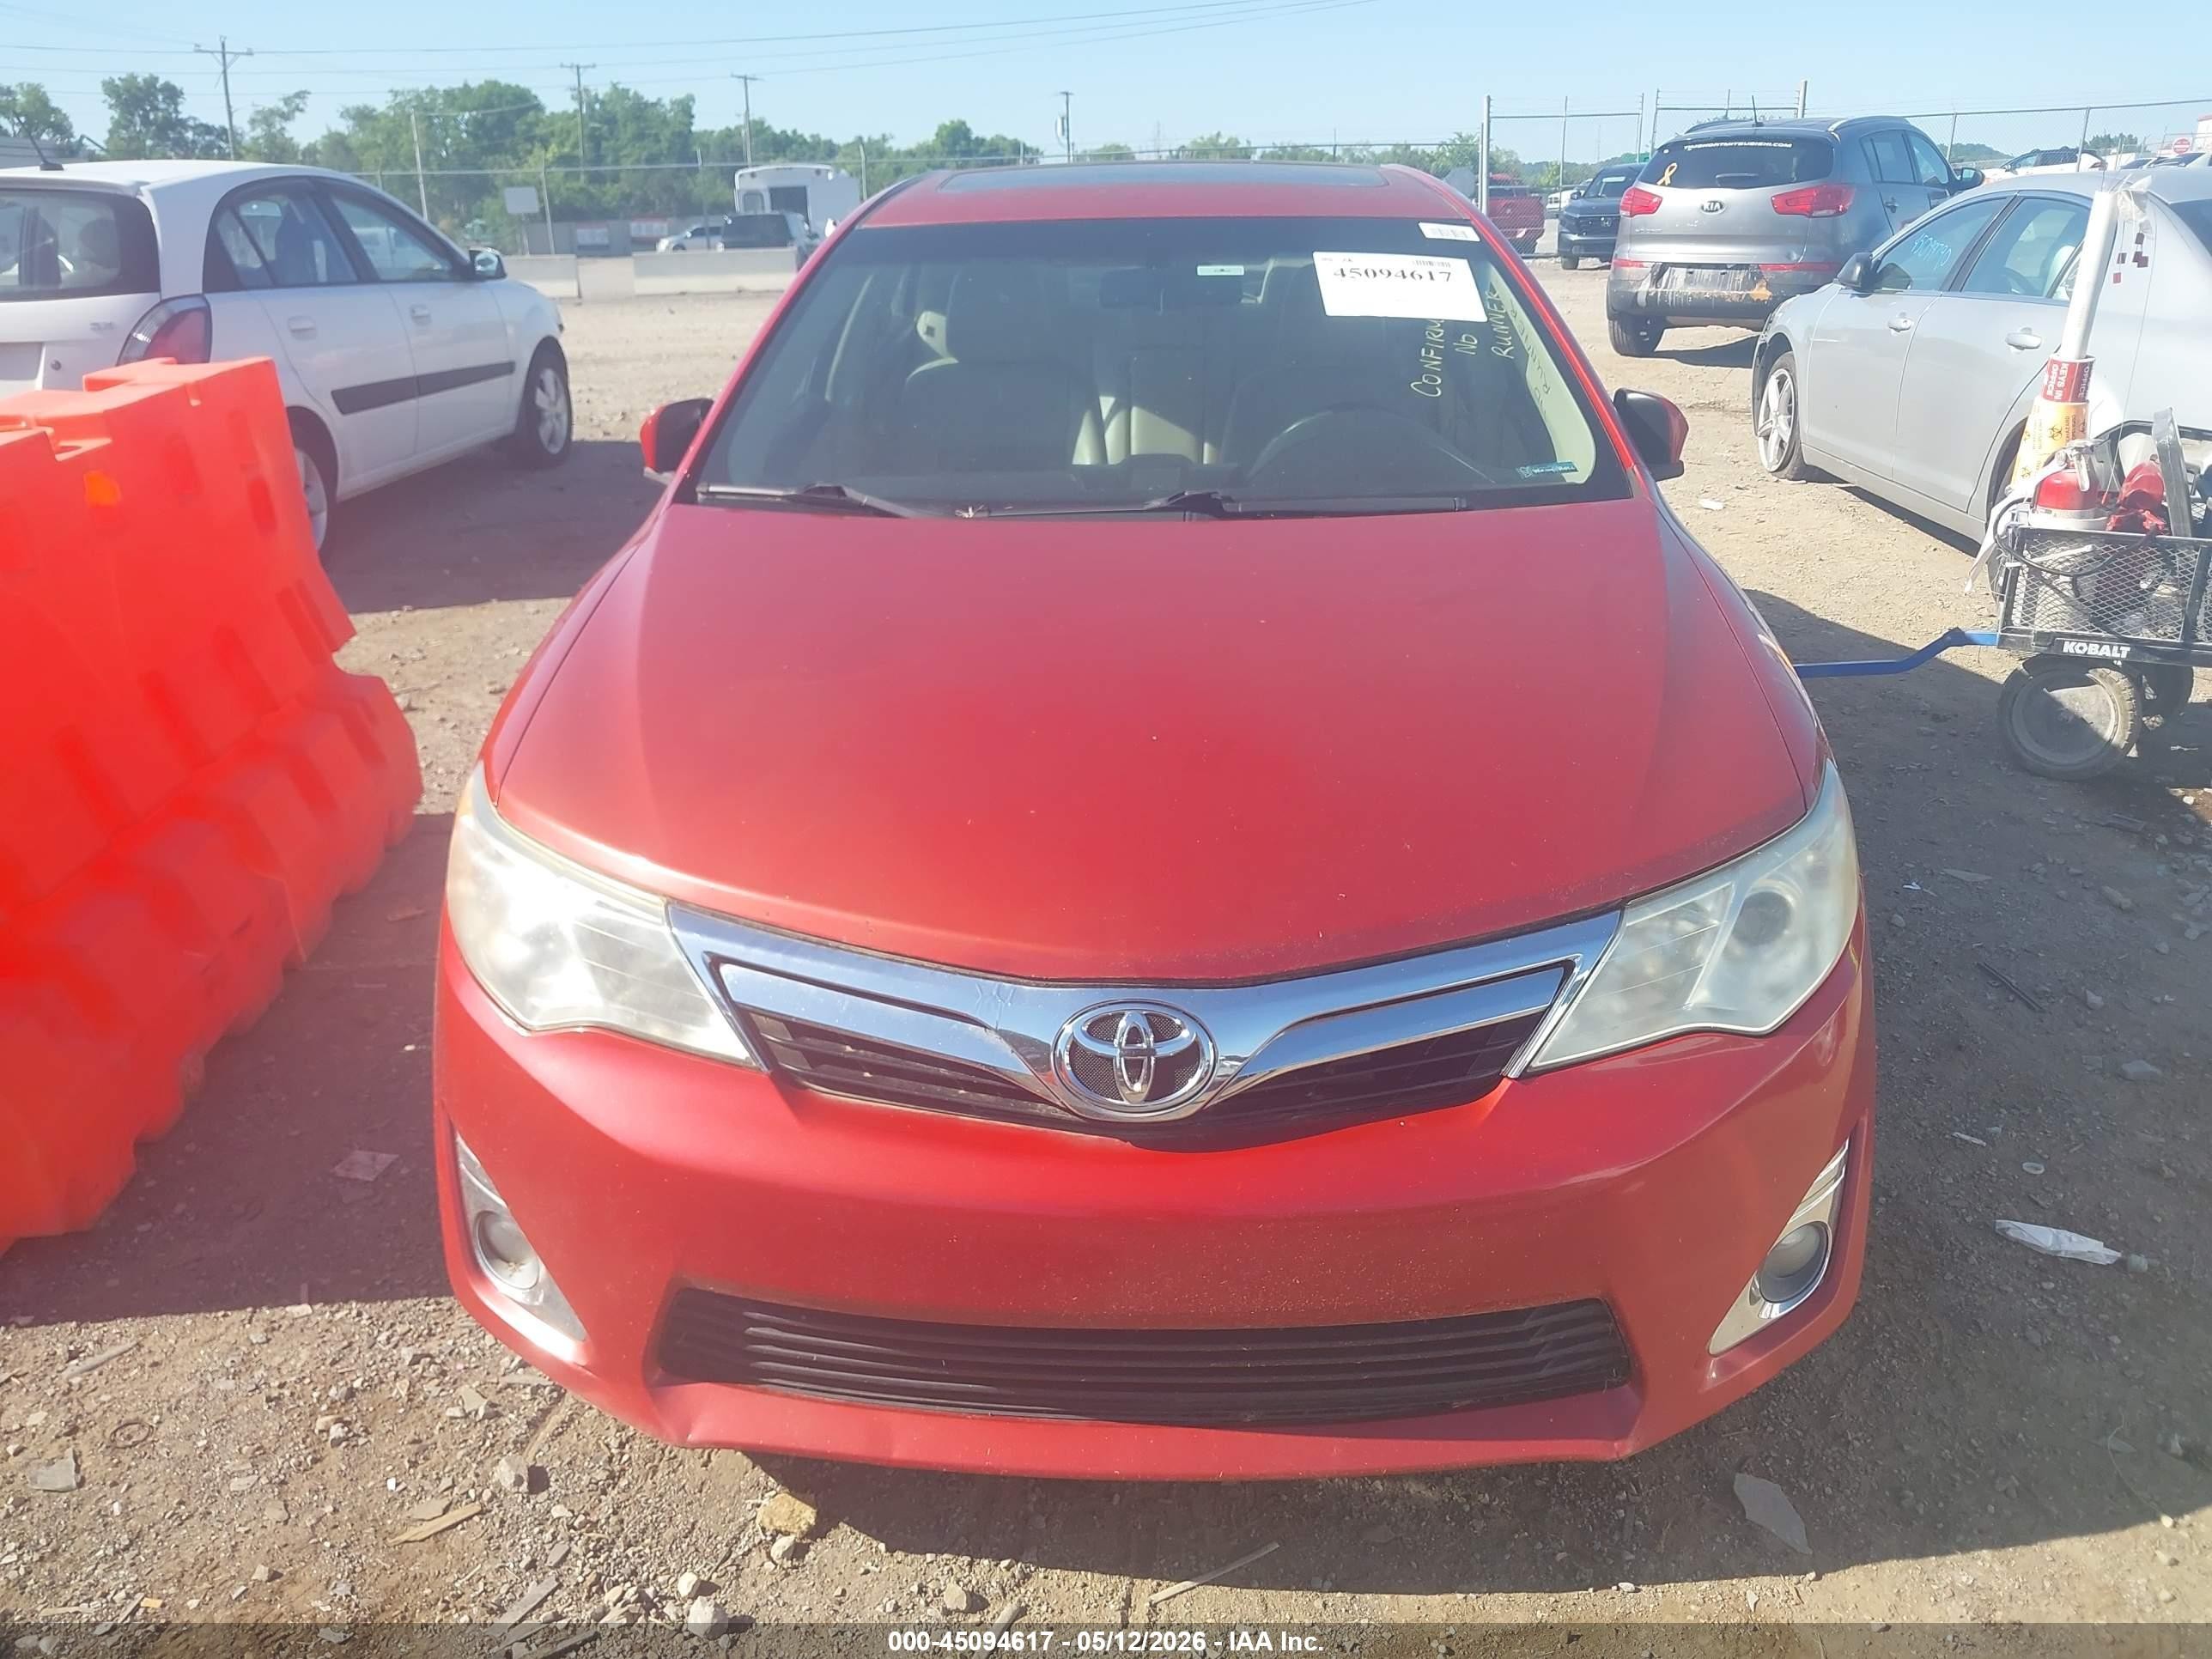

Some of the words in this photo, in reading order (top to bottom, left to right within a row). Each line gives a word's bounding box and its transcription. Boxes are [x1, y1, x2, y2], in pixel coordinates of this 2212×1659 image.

[1703, 201, 1723, 212] KIA
[1334, 266, 1452, 283] 45094617
[1485, 290, 1516, 359] RUNNER
[2046, 363, 2059, 396] OFFICE
[2057, 363, 2069, 389] KEYS
[2053, 389, 2063, 400] IN
[2063, 641, 2131, 659] KOBALT
